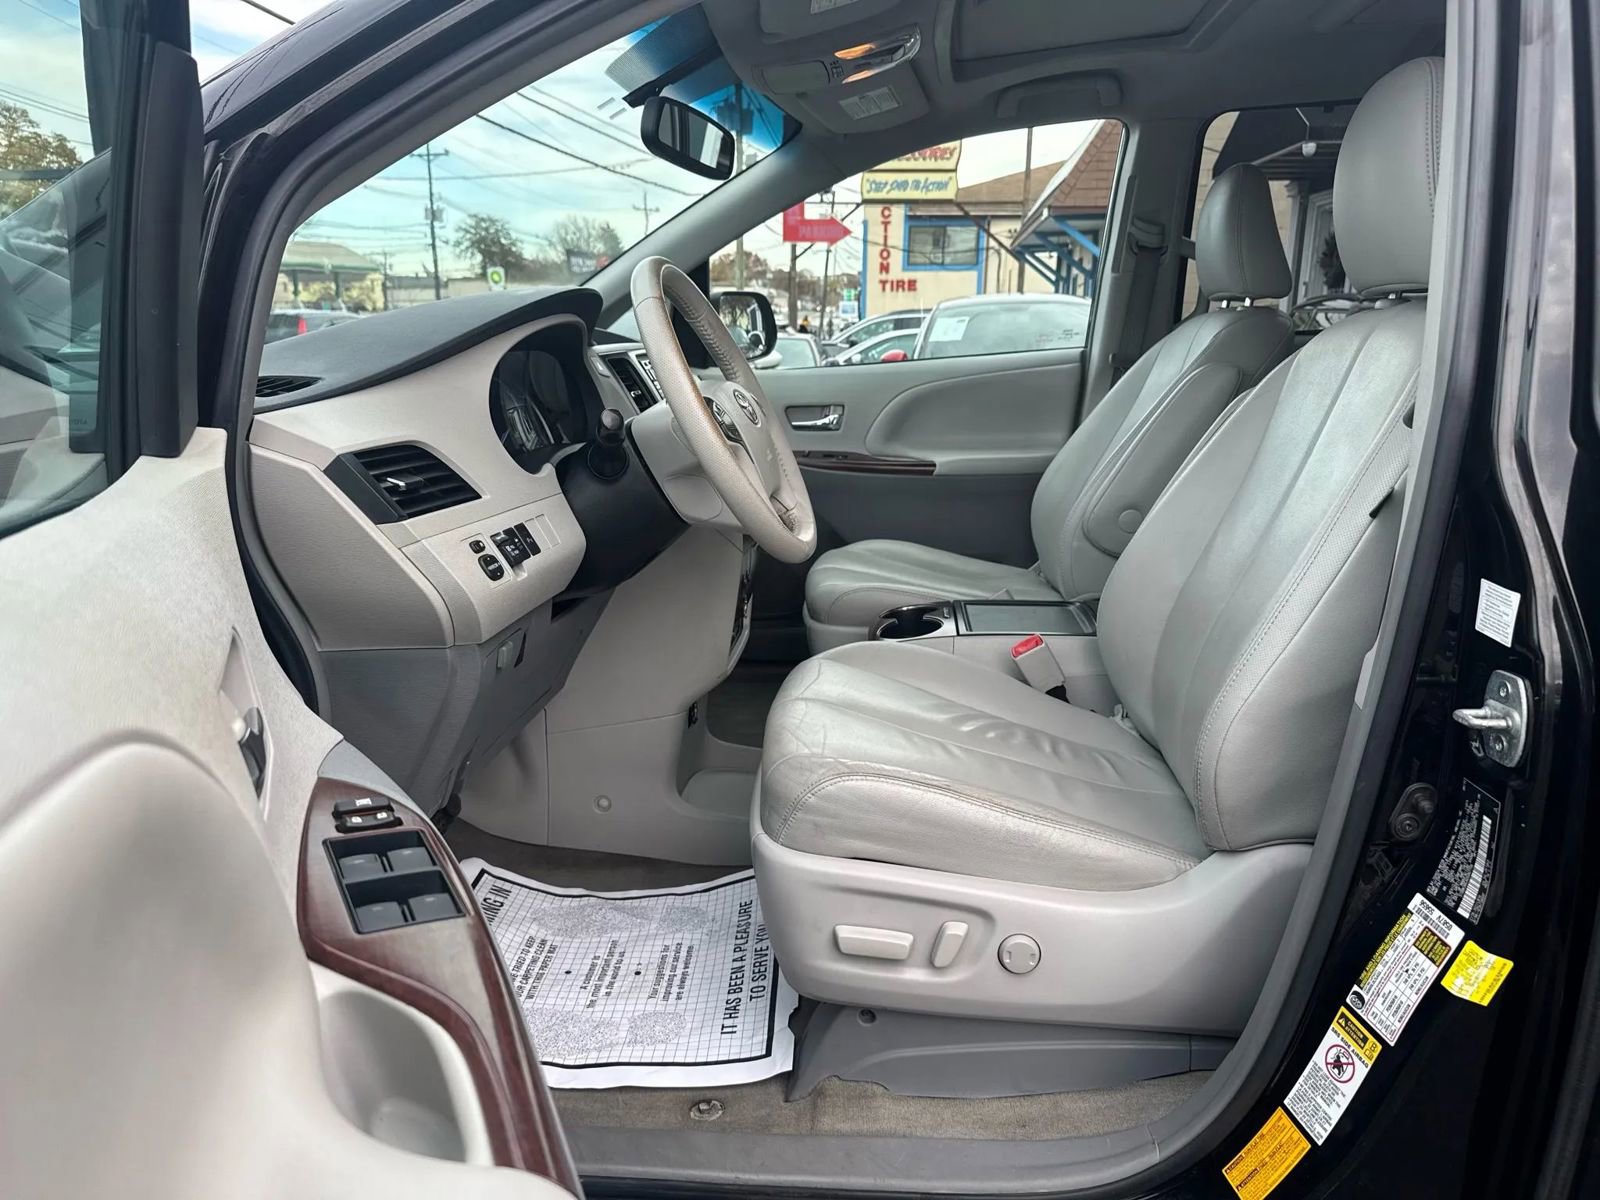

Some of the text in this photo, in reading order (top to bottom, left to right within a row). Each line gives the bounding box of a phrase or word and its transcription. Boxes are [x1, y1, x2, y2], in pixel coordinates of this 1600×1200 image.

[879, 279, 917, 292] TIRE
[489, 884, 512, 899] IN
[733, 899, 752, 952] PLEASURE
[513, 955, 526, 972] TRIED
[526, 935, 535, 948] KEEP
[522, 953, 540, 983] CARPETING
[535, 938, 547, 956] CLEAN
[751, 945, 769, 982] SERVE
[591, 981, 603, 997] most
[598, 958, 612, 982] important
[654, 953, 668, 986] suggestions
[677, 970, 689, 989] always
[728, 964, 746, 994] BEEN
[676, 990, 684, 1000] are
[723, 997, 741, 1019] HAS
[750, 986, 766, 1001] TO
[721, 1024, 737, 1034] IT
[1340, 1037, 1352, 1050] SIDE
[1351, 1049, 1369, 1069] AIRBAG
